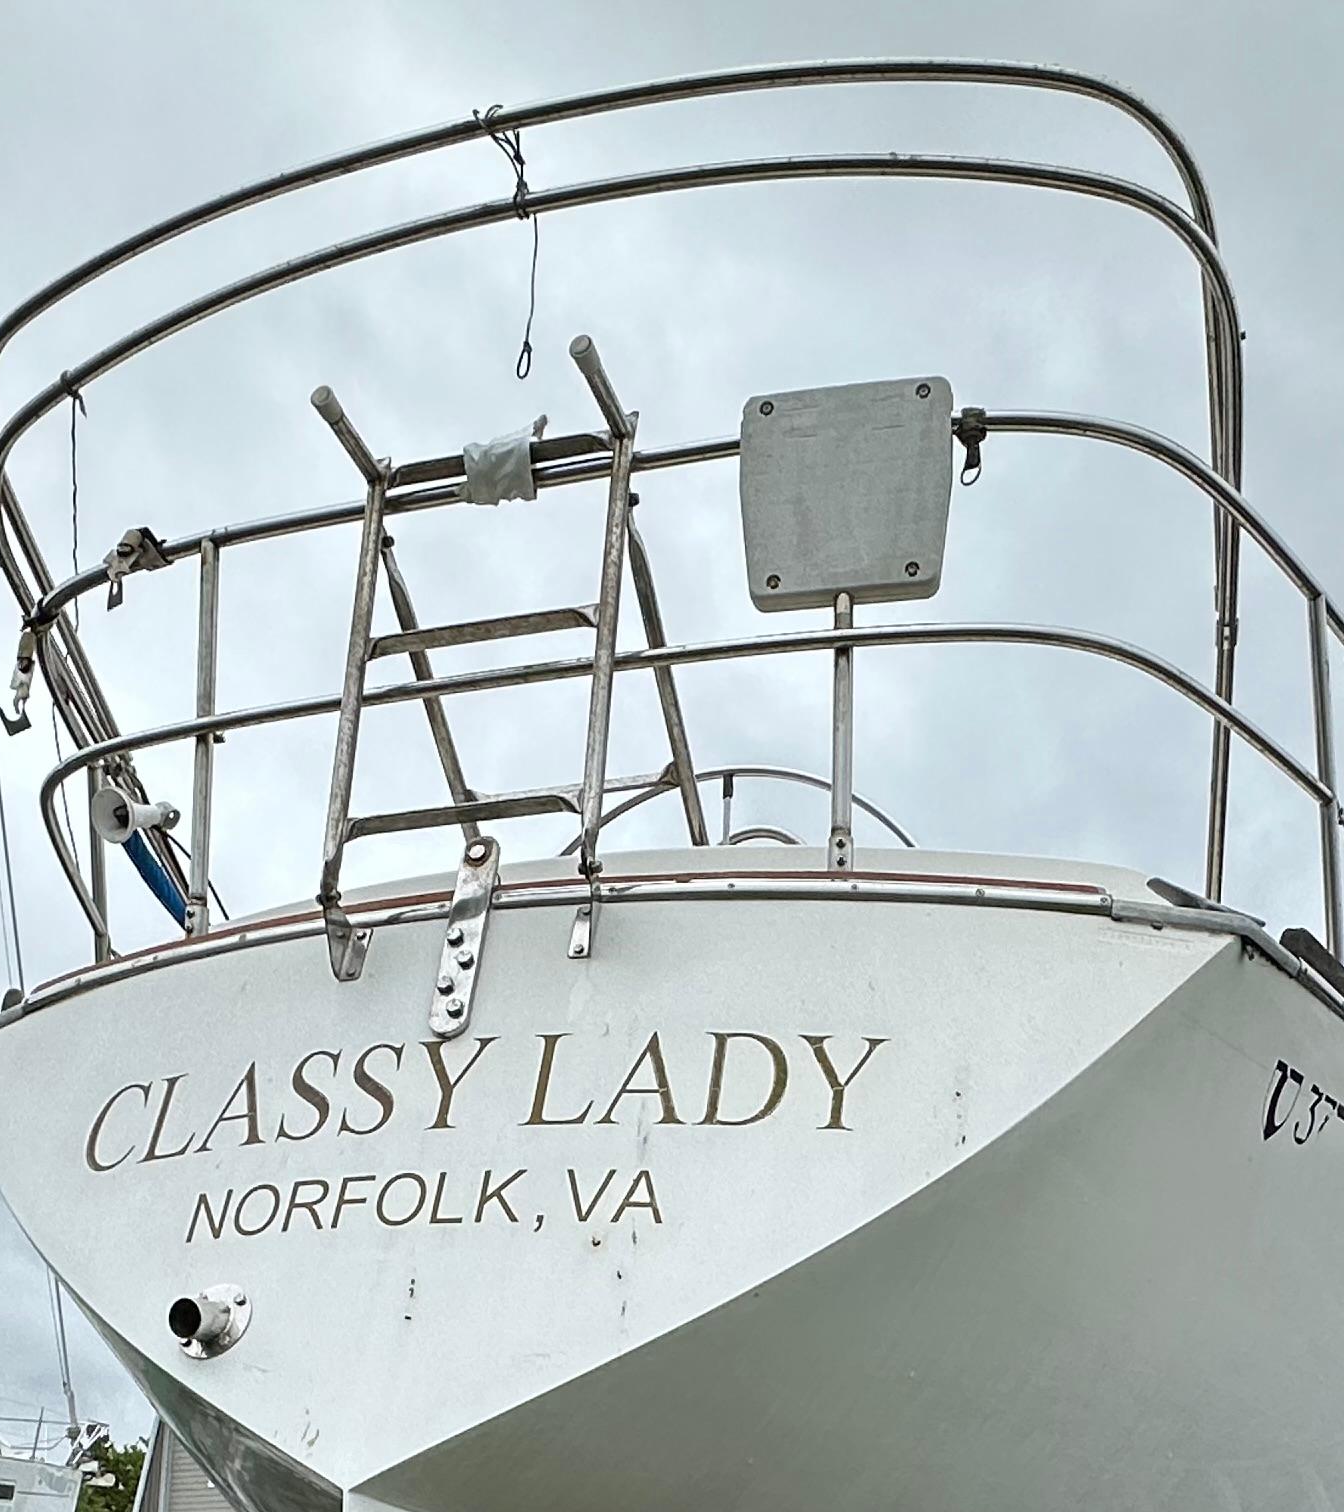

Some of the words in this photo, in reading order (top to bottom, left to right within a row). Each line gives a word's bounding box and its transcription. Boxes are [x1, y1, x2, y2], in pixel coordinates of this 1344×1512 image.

[85, 1037, 500, 1172] CLASSY
[521, 1031, 891, 1131] LADY
[186, 1169, 545, 1243] NORFOLK,
[568, 1169, 664, 1224] VA
